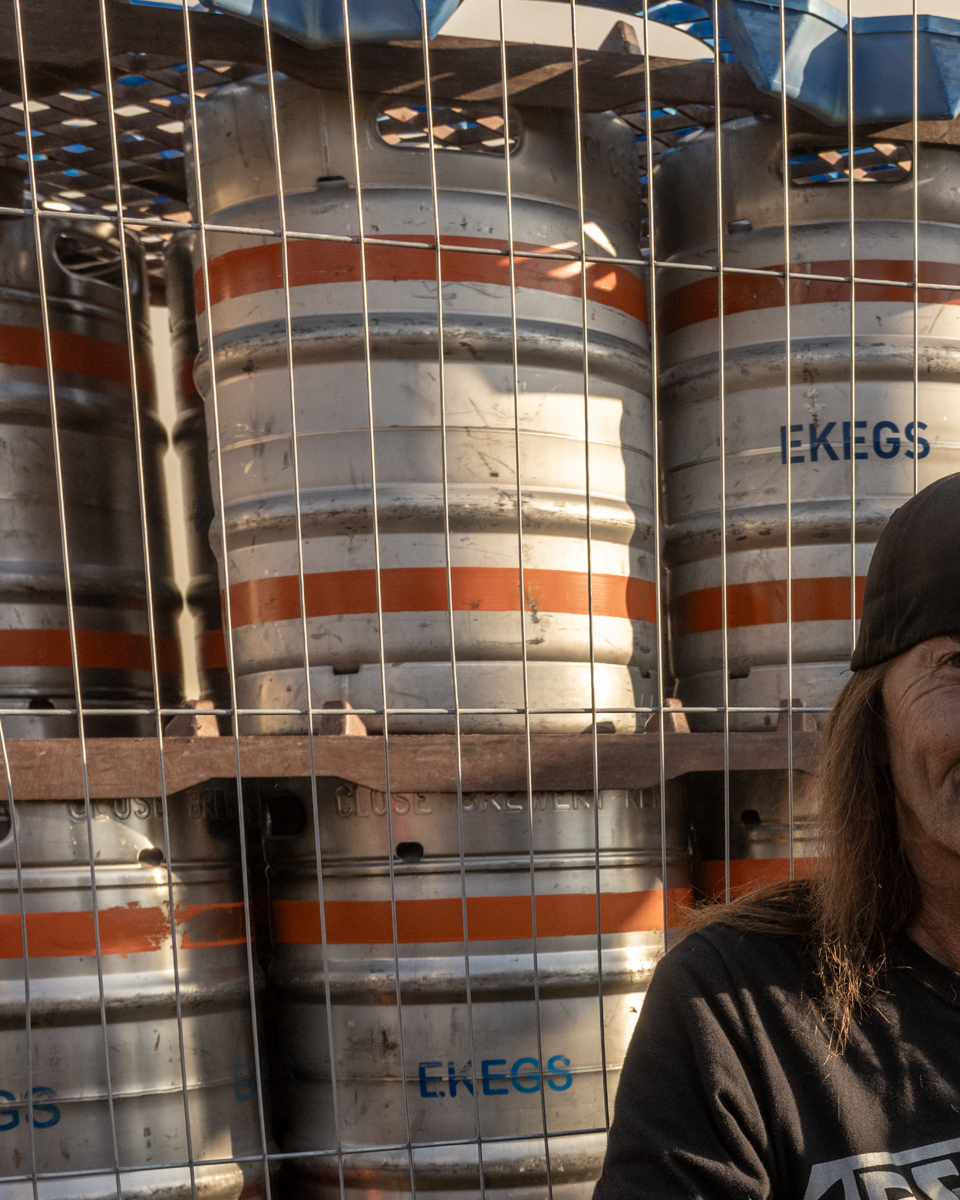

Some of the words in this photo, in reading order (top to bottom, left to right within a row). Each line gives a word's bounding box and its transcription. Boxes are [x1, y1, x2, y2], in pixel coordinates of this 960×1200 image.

[780, 420, 930, 464] EKEGS
[334, 785, 433, 818] CLOSE
[418, 1055, 573, 1098] EKEGS
